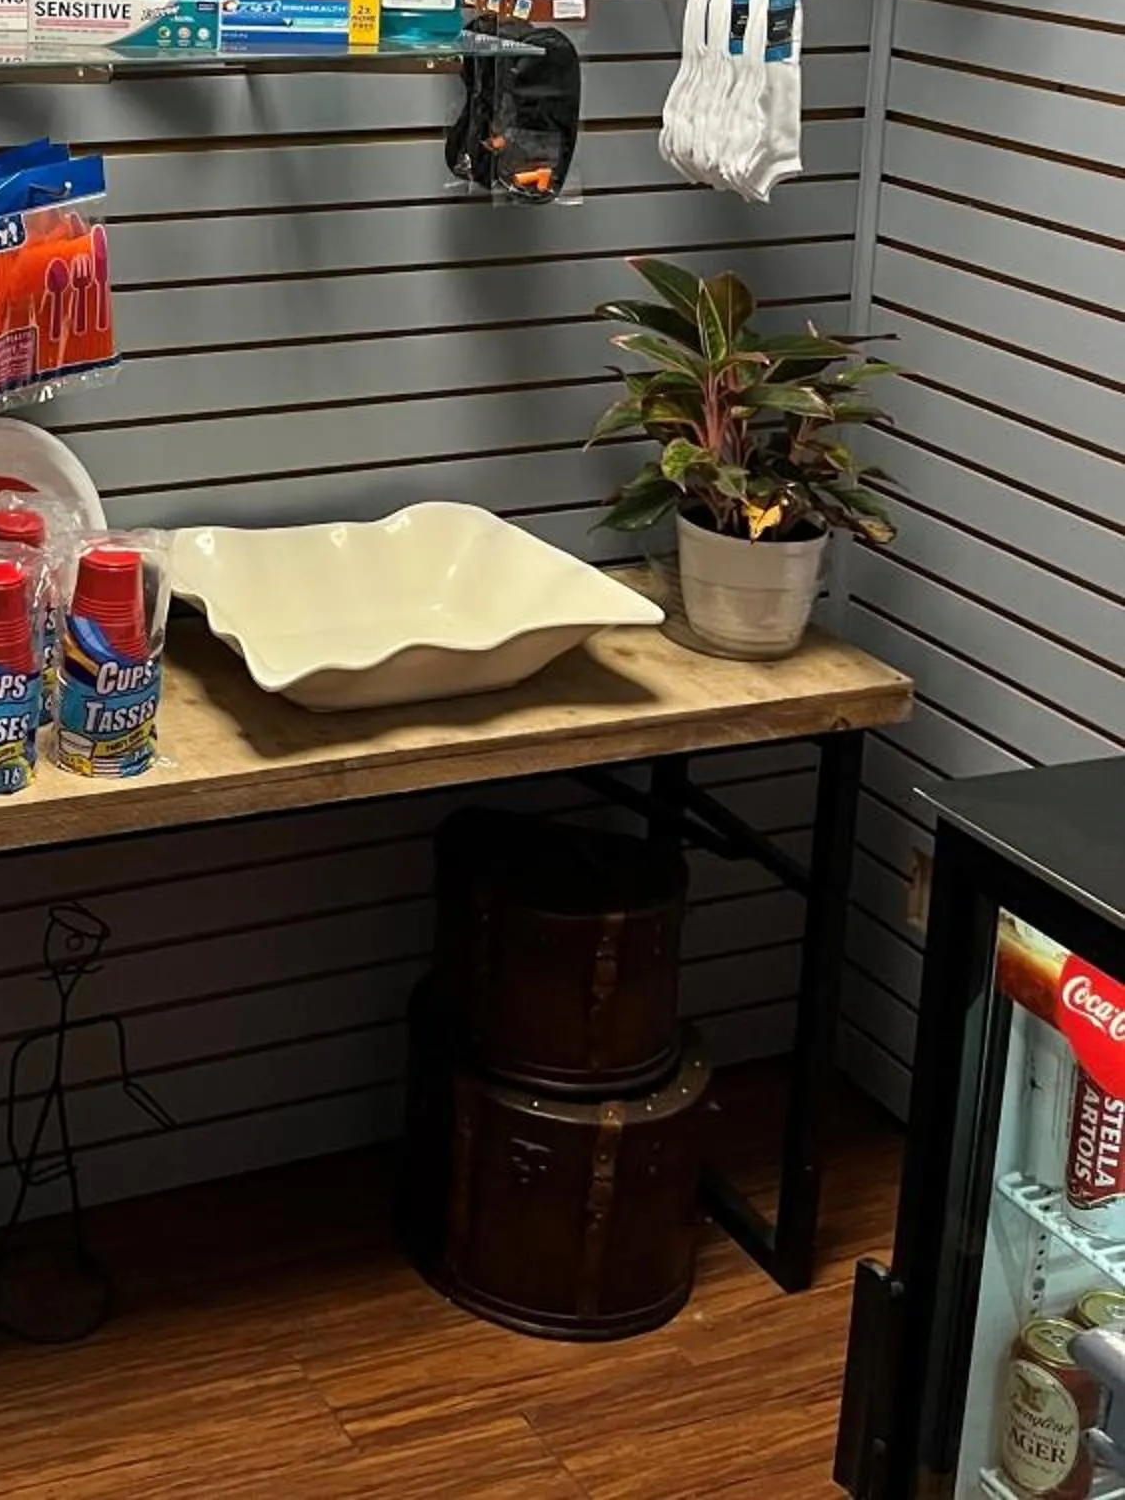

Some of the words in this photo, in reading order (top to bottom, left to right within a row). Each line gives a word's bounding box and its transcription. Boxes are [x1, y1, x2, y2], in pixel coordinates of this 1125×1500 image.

[34, 1, 132, 20] SENSITIVE
[96, 662, 153, 695] CUPS
[85, 697, 156, 733] TASSES
[1074, 1082, 1101, 1182] ARTOIS
[1093, 1096, 1125, 1188] STELLA
[1012, 1425, 1069, 1464] AGER
